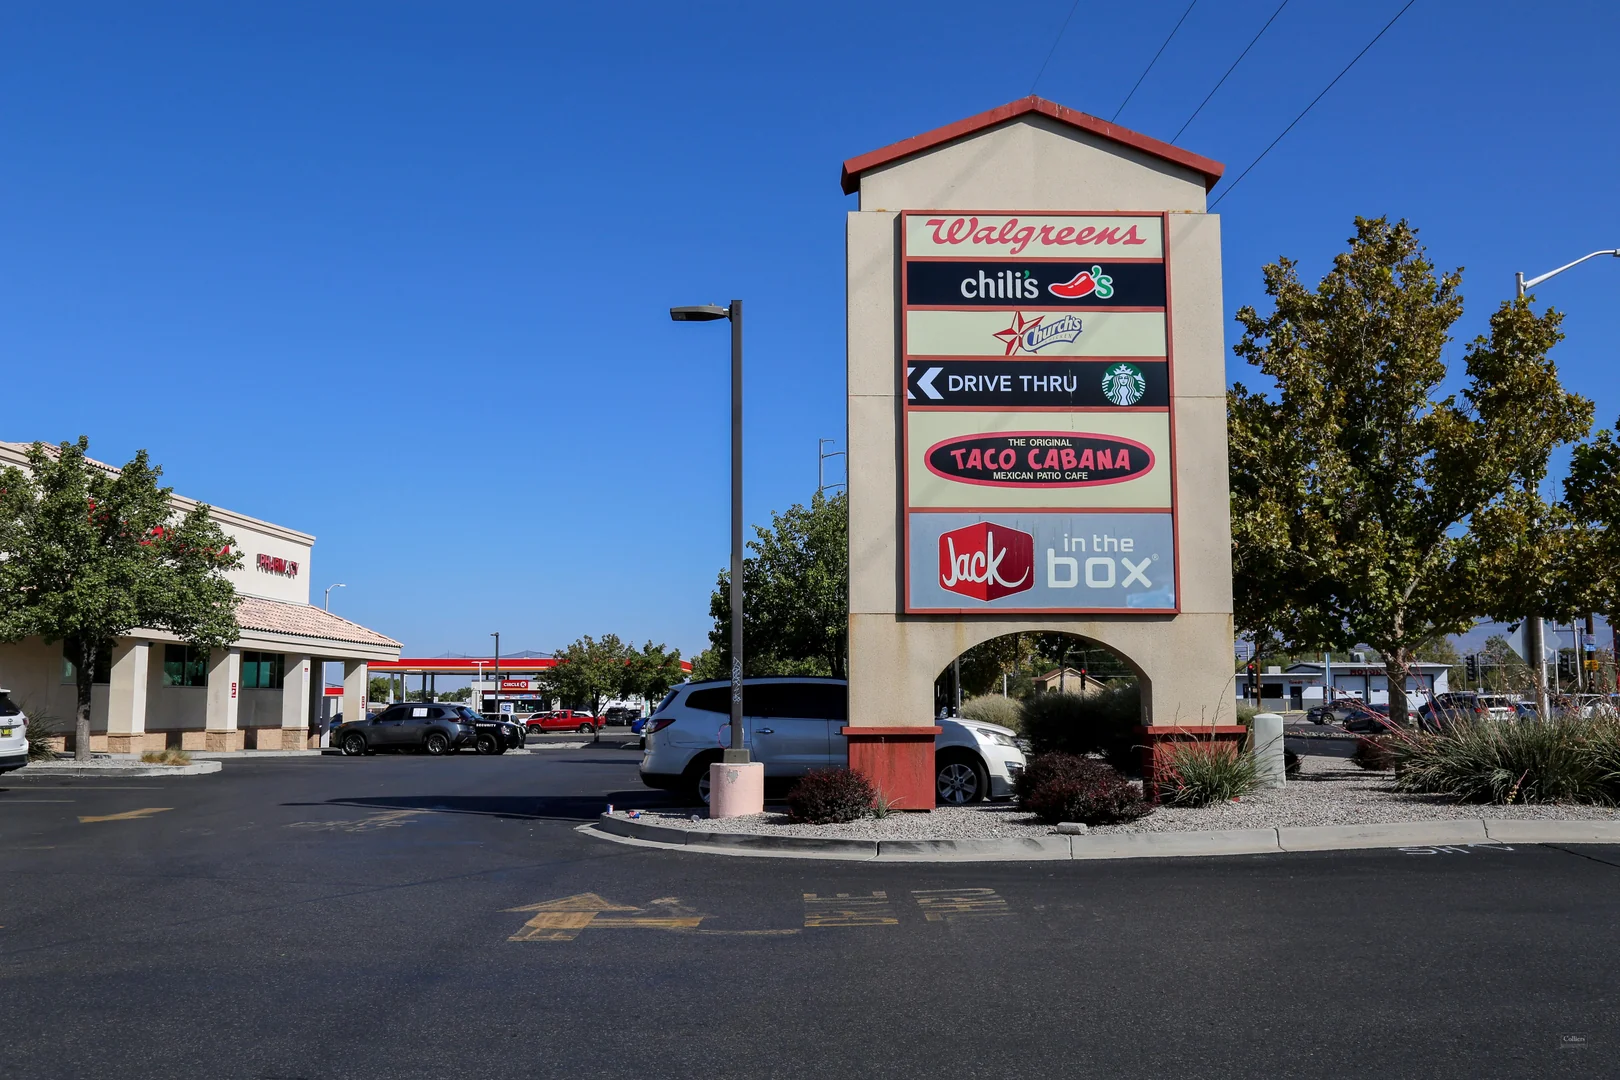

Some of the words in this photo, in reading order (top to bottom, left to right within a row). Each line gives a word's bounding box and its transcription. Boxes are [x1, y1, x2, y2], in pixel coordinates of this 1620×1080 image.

[925, 217, 1147, 255] Walgreens
[1022, 315, 1082, 352] Church's
[948, 375, 1012, 392] DRIVE
[1019, 375, 1078, 393] THRU
[1008, 438, 1026, 447] THE
[1029, 438, 1072, 447] ORIGINAL
[950, 448, 1016, 470] TACO
[1027, 448, 1131, 471] CABANA
[993, 471, 1034, 480] MEXICAN
[1036, 471, 1061, 480] PATIO
[1064, 471, 1088, 480] CAFE
[1063, 533, 1086, 552] in
[1092, 534, 1134, 552] the
[258, 553, 299, 577] PHARMACY
[942, 531, 1030, 588] Jack
[1047, 548, 1152, 588] box
